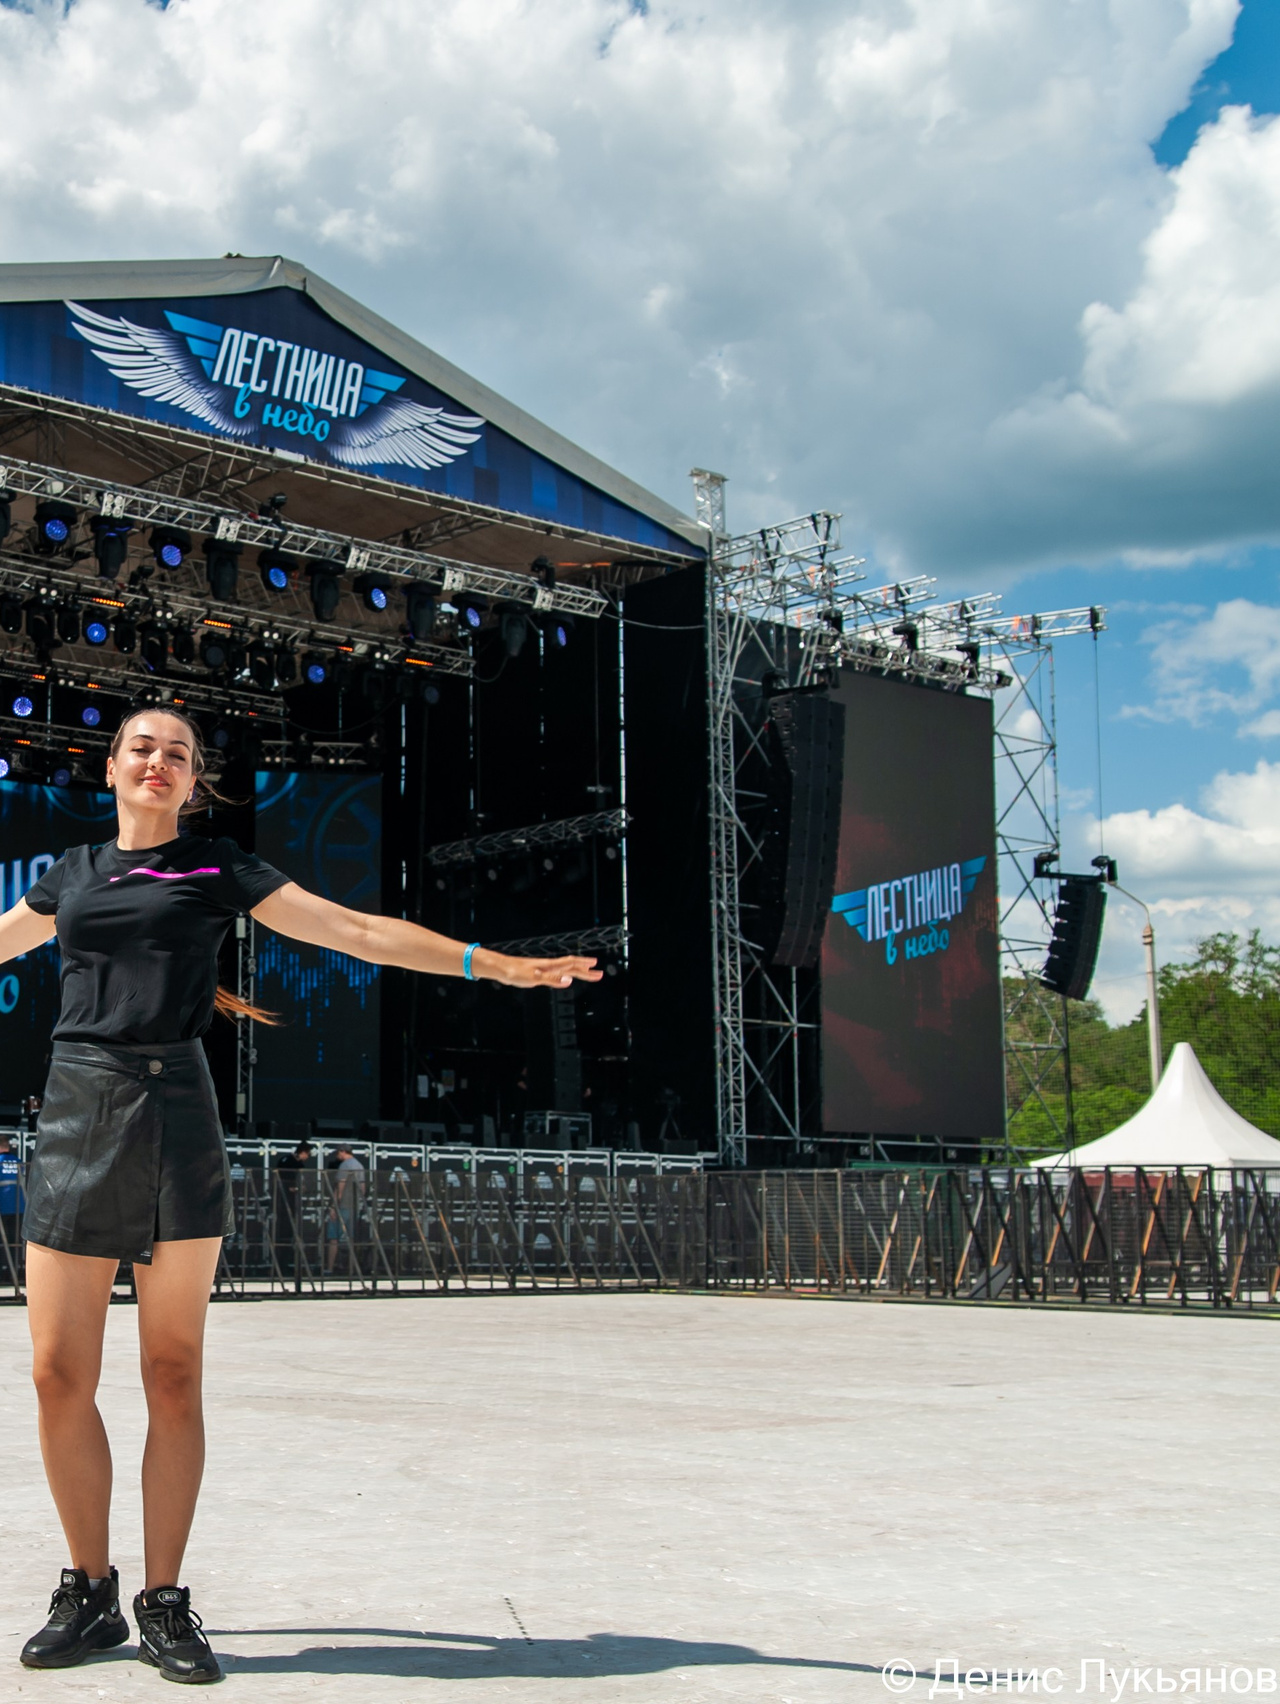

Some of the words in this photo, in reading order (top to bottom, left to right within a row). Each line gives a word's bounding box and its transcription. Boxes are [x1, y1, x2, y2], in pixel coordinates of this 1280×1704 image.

[211, 327, 365, 418] ЛЕСТНИЦА
[235, 383, 252, 420] в
[262, 402, 331, 442] небо
[867, 863, 963, 943] ЛЕСТНИЦА
[885, 930, 898, 966] в
[904, 921, 950, 960] небо
